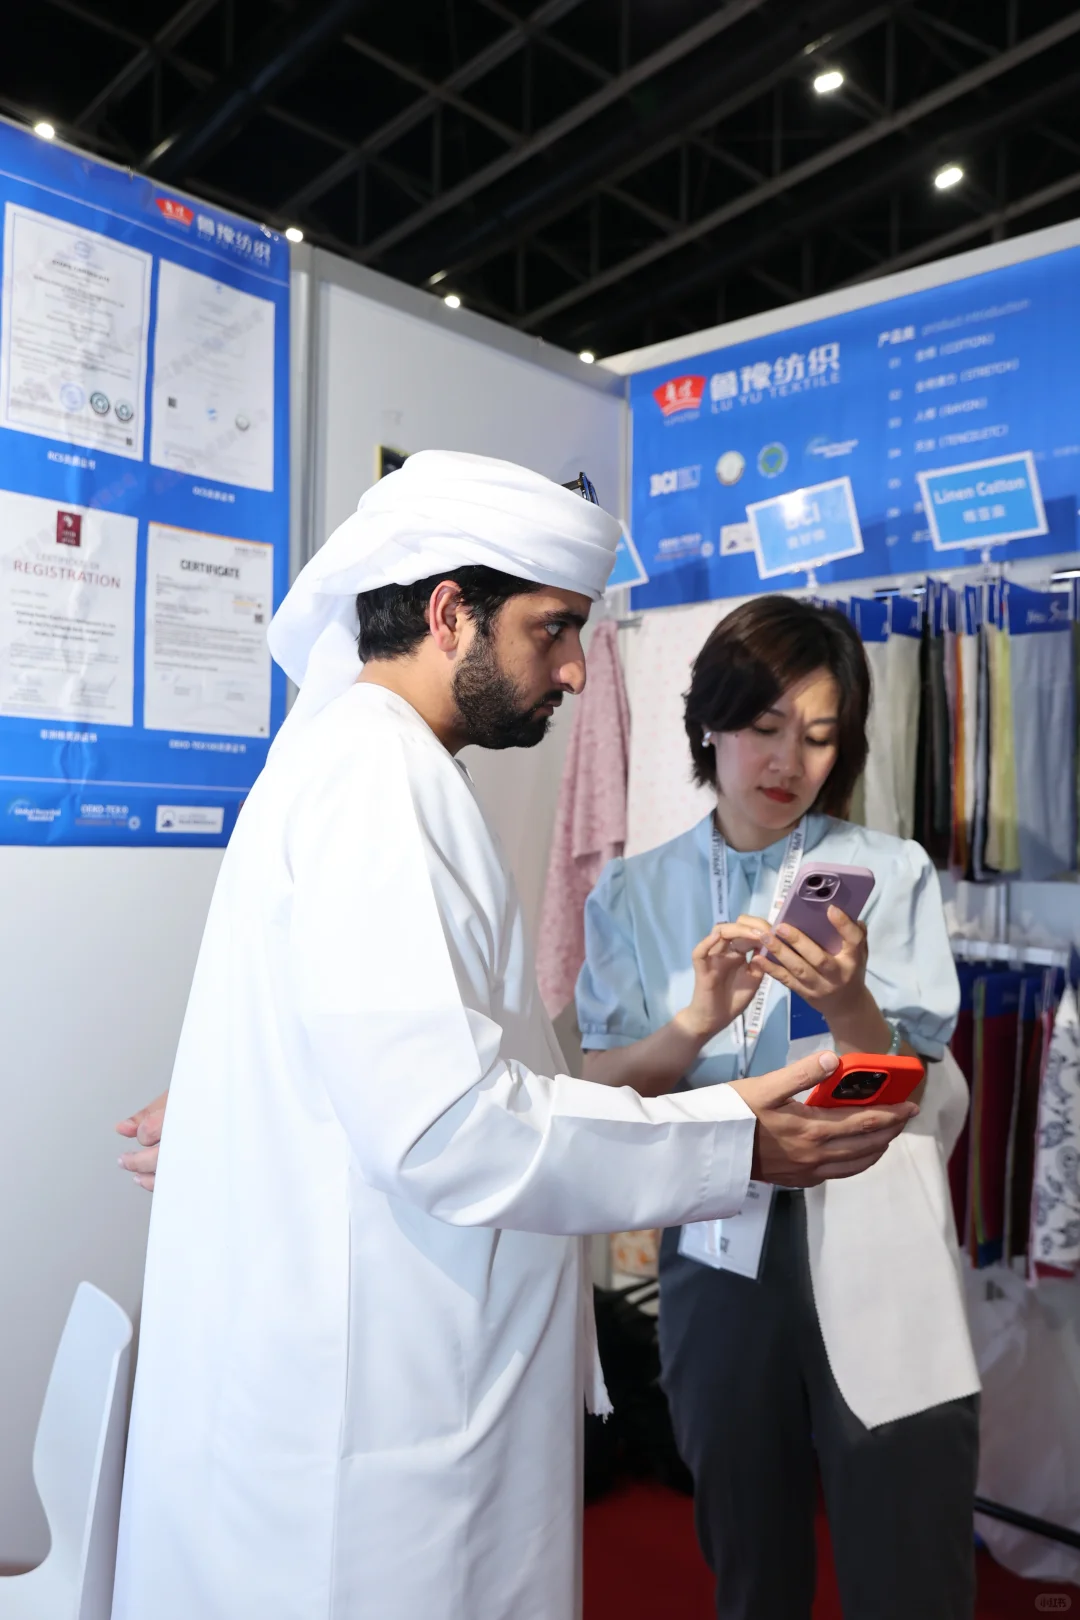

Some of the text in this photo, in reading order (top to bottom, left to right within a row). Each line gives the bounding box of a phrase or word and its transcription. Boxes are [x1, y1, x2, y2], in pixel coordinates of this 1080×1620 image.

[711, 371, 841, 415] LU YU TEXTILE
[933, 478, 1025, 504] Linen Cotton
[14, 560, 121, 588] REGISTRATION
[180, 559, 240, 580] CERTIFICATE
[751, 997, 764, 1028] TEXTILE
